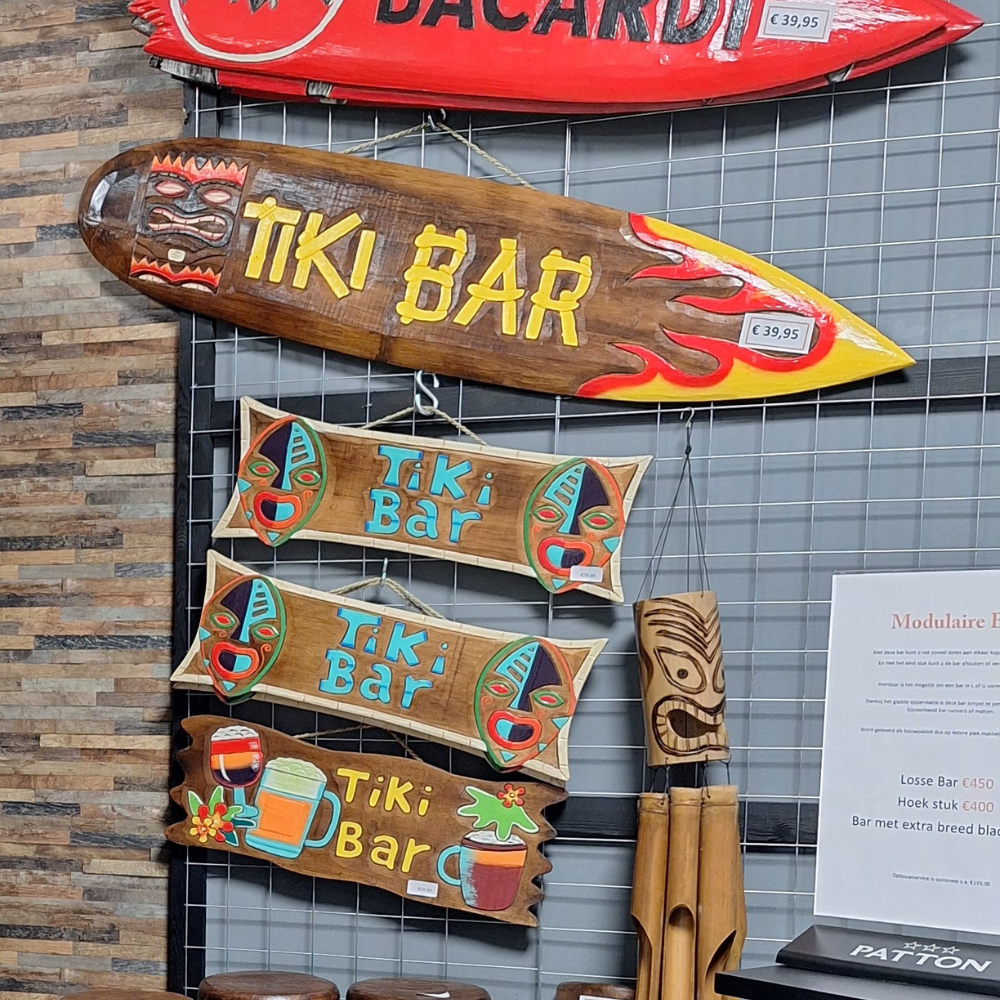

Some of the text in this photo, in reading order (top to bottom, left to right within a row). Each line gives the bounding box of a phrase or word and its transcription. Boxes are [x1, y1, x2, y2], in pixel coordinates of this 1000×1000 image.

[781, 14, 819, 30] 39,95
[244, 196, 594, 348] TIKI BAR
[763, 325, 799, 340] 39,95
[365, 489, 483, 543] Bar
[891, 612, 986, 629] Modulaire
[319, 648, 434, 710] Bar
[900, 774, 994, 789] Losse Bar €450
[897, 796, 994, 812] Hoek stuk €400
[852, 815, 872, 827] Bar
[875, 818, 899, 829] met
[902, 820, 933, 832] extra
[937, 820, 974, 835] breed
[335, 821, 431, 874] Bar
[849, 944, 993, 973] PATTON
